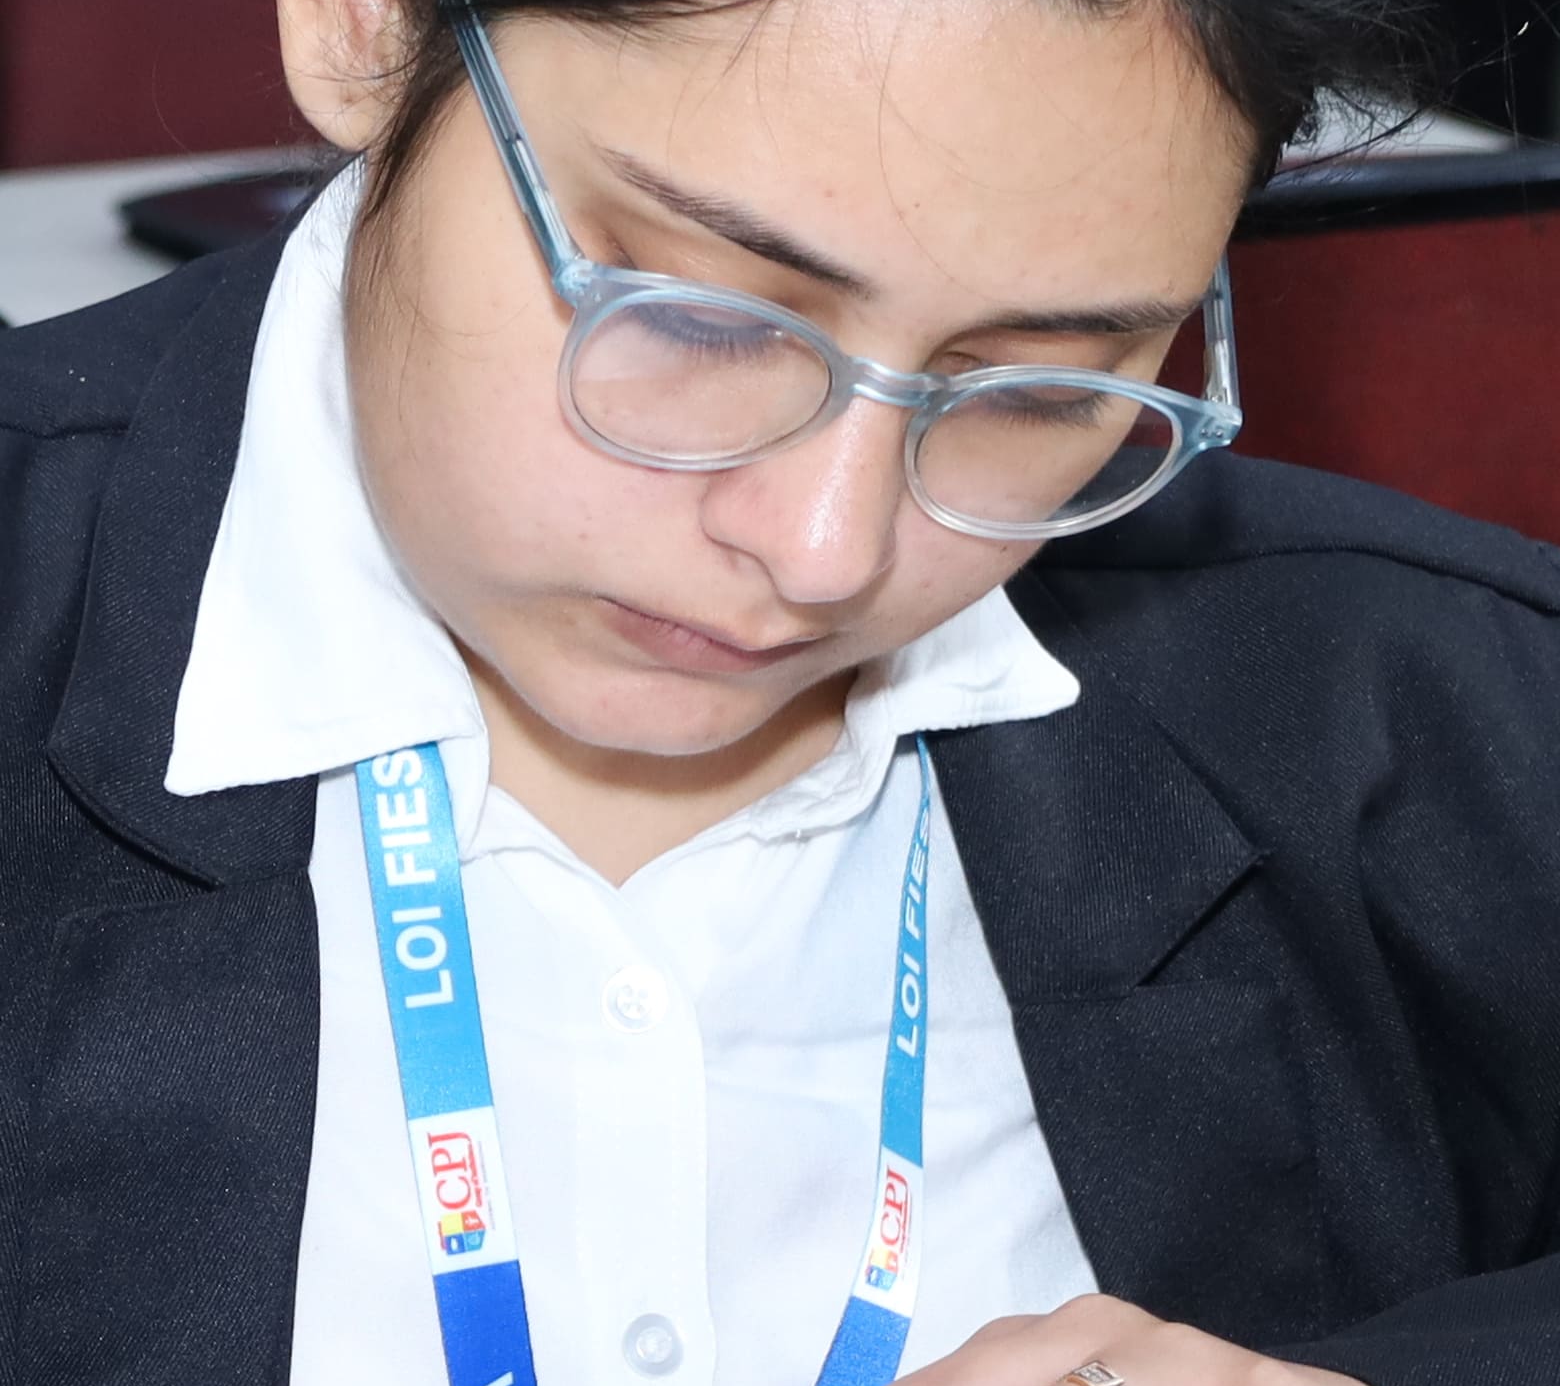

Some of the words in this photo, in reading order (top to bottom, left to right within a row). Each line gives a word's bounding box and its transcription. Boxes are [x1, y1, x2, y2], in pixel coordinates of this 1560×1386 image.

[371, 747, 437, 887] FIES
[392, 905, 455, 1009] LOI
[896, 952, 921, 1058] LOI
[427, 1132, 472, 1211] CPJ
[881, 1165, 908, 1247] CPJ
